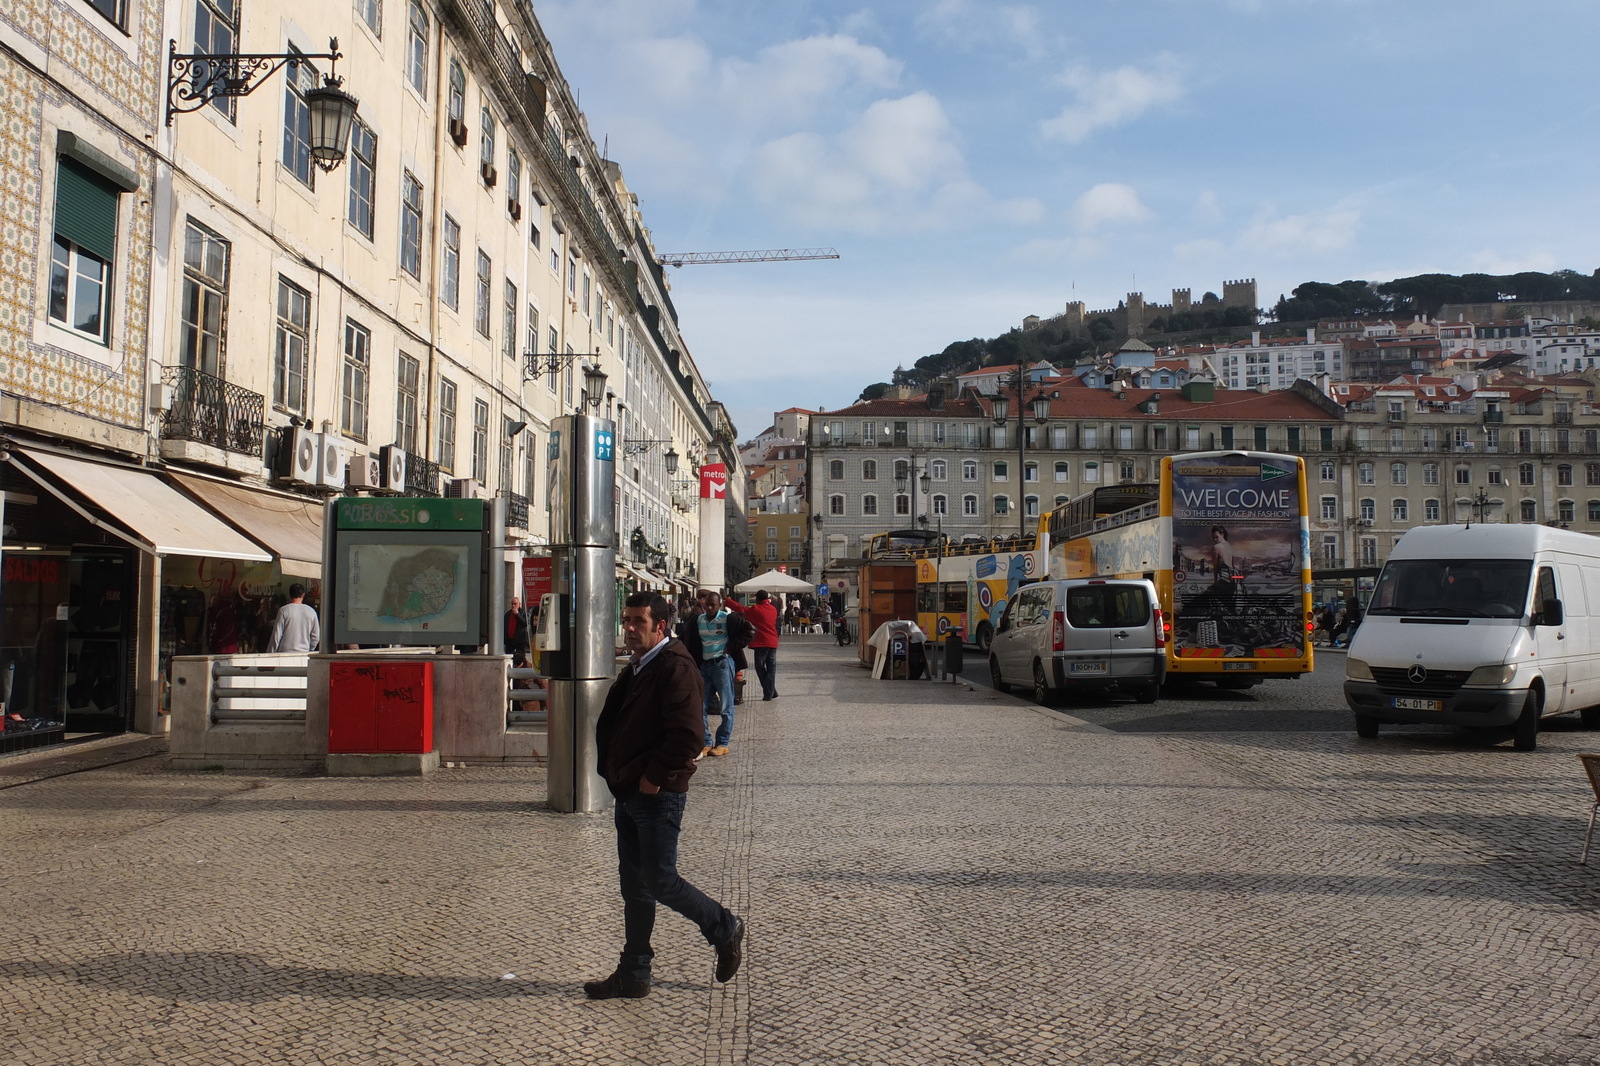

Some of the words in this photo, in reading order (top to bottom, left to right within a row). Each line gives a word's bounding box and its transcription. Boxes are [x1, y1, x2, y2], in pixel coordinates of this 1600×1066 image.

[598, 446, 611, 458] PT
[703, 471, 725, 479] metro
[1181, 488, 1290, 509] WELCOME
[1181, 509, 1192, 518] TO
[1193, 509, 1206, 518] THE
[1207, 509, 1224, 518] BEST
[1224, 509, 1247, 519] PLACE
[1247, 510, 1256, 519] IN
[1257, 510, 1290, 519] FASHION
[5, 556, 59, 584] SALDOS
[894, 641, 903, 654] P
